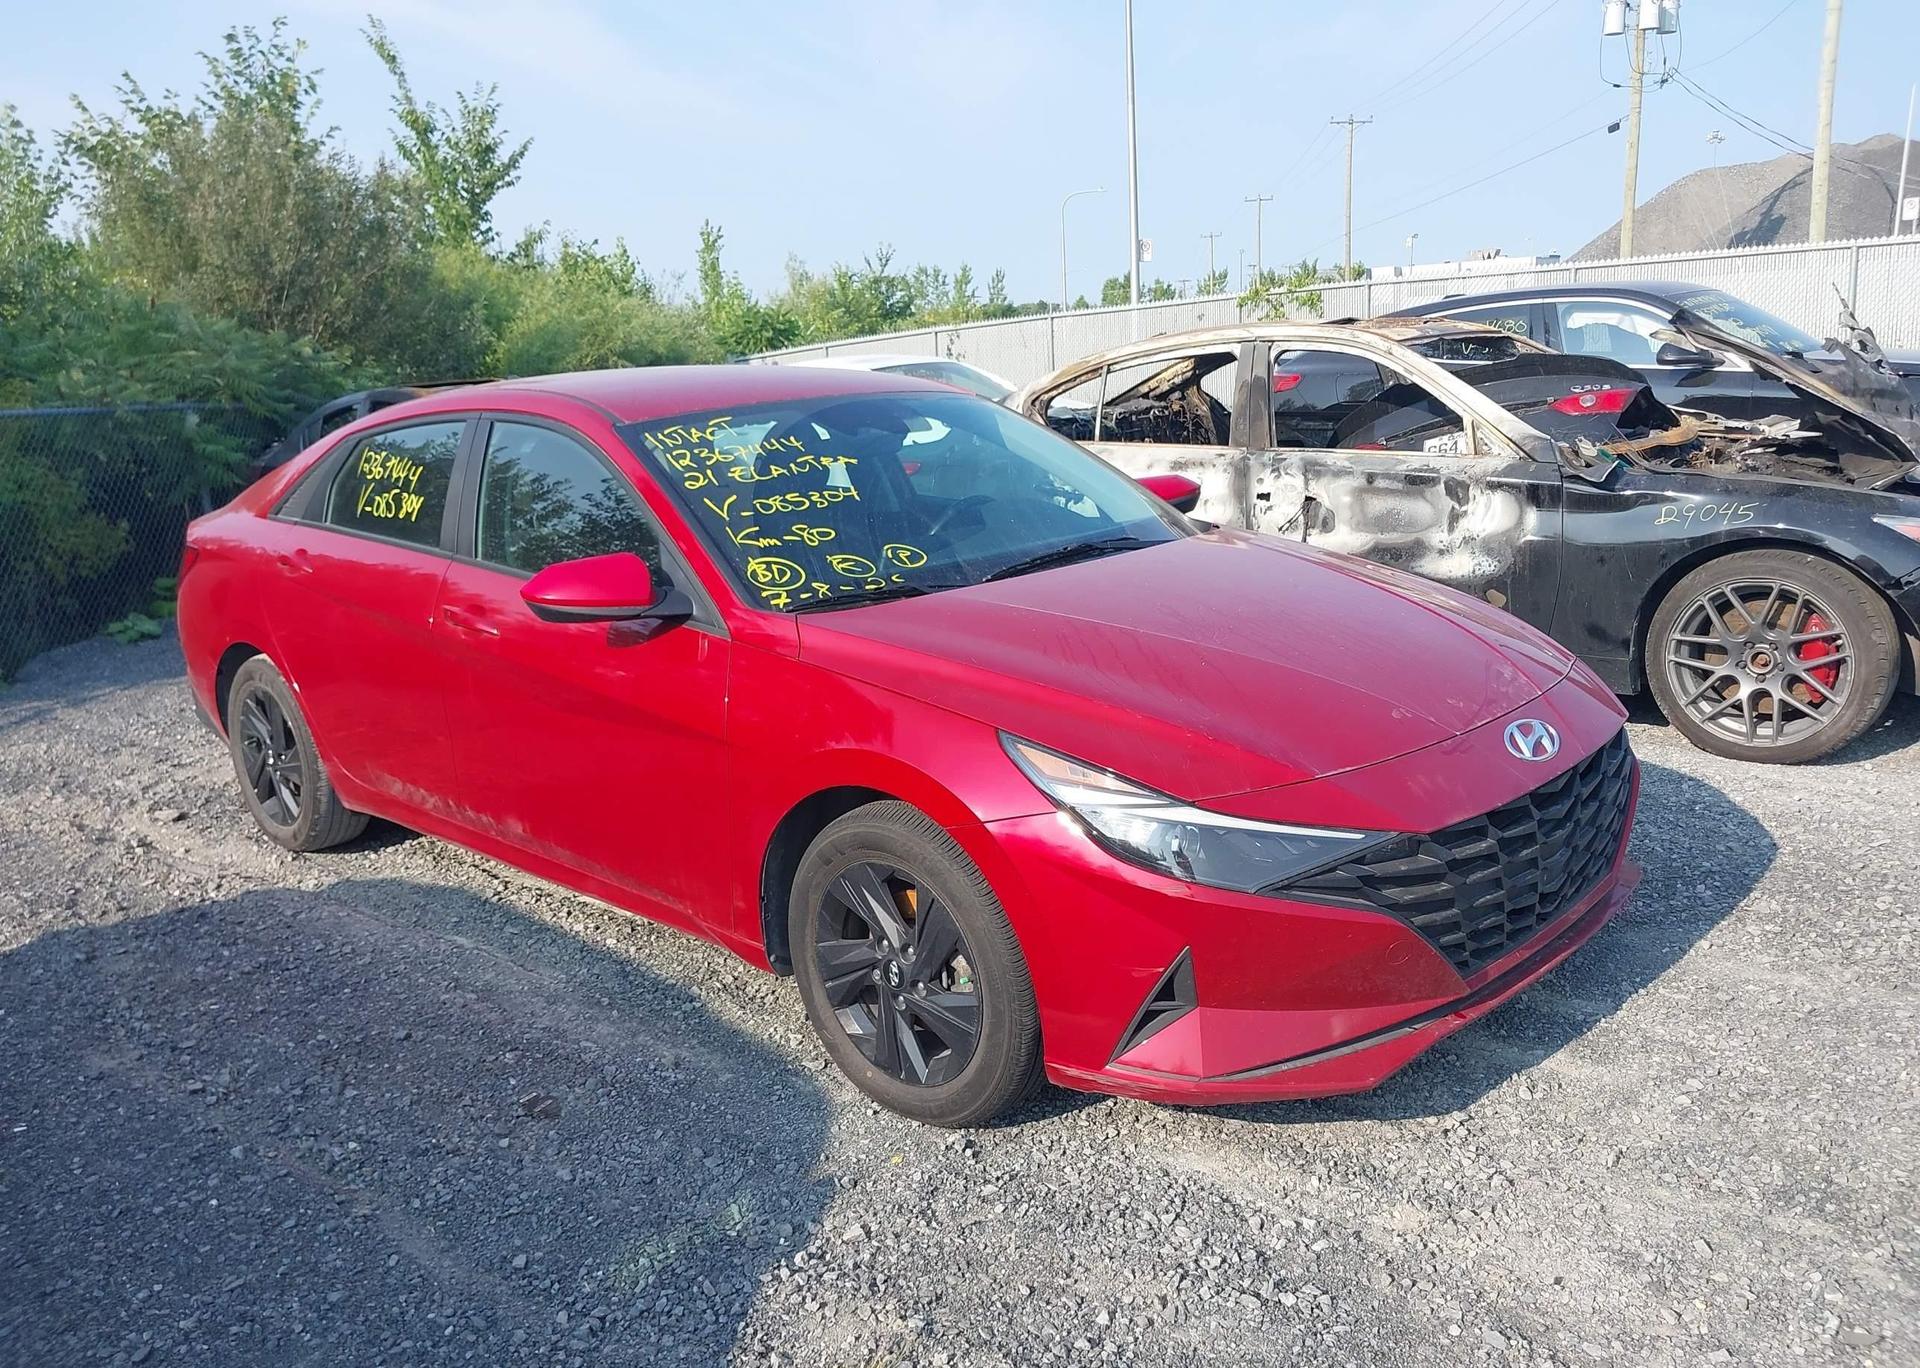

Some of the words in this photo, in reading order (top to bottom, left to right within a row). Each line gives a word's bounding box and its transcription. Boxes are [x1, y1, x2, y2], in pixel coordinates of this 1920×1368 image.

[643, 416, 738, 450] INTACT
[666, 435, 806, 472] 12367444
[683, 469, 720, 490] 21
